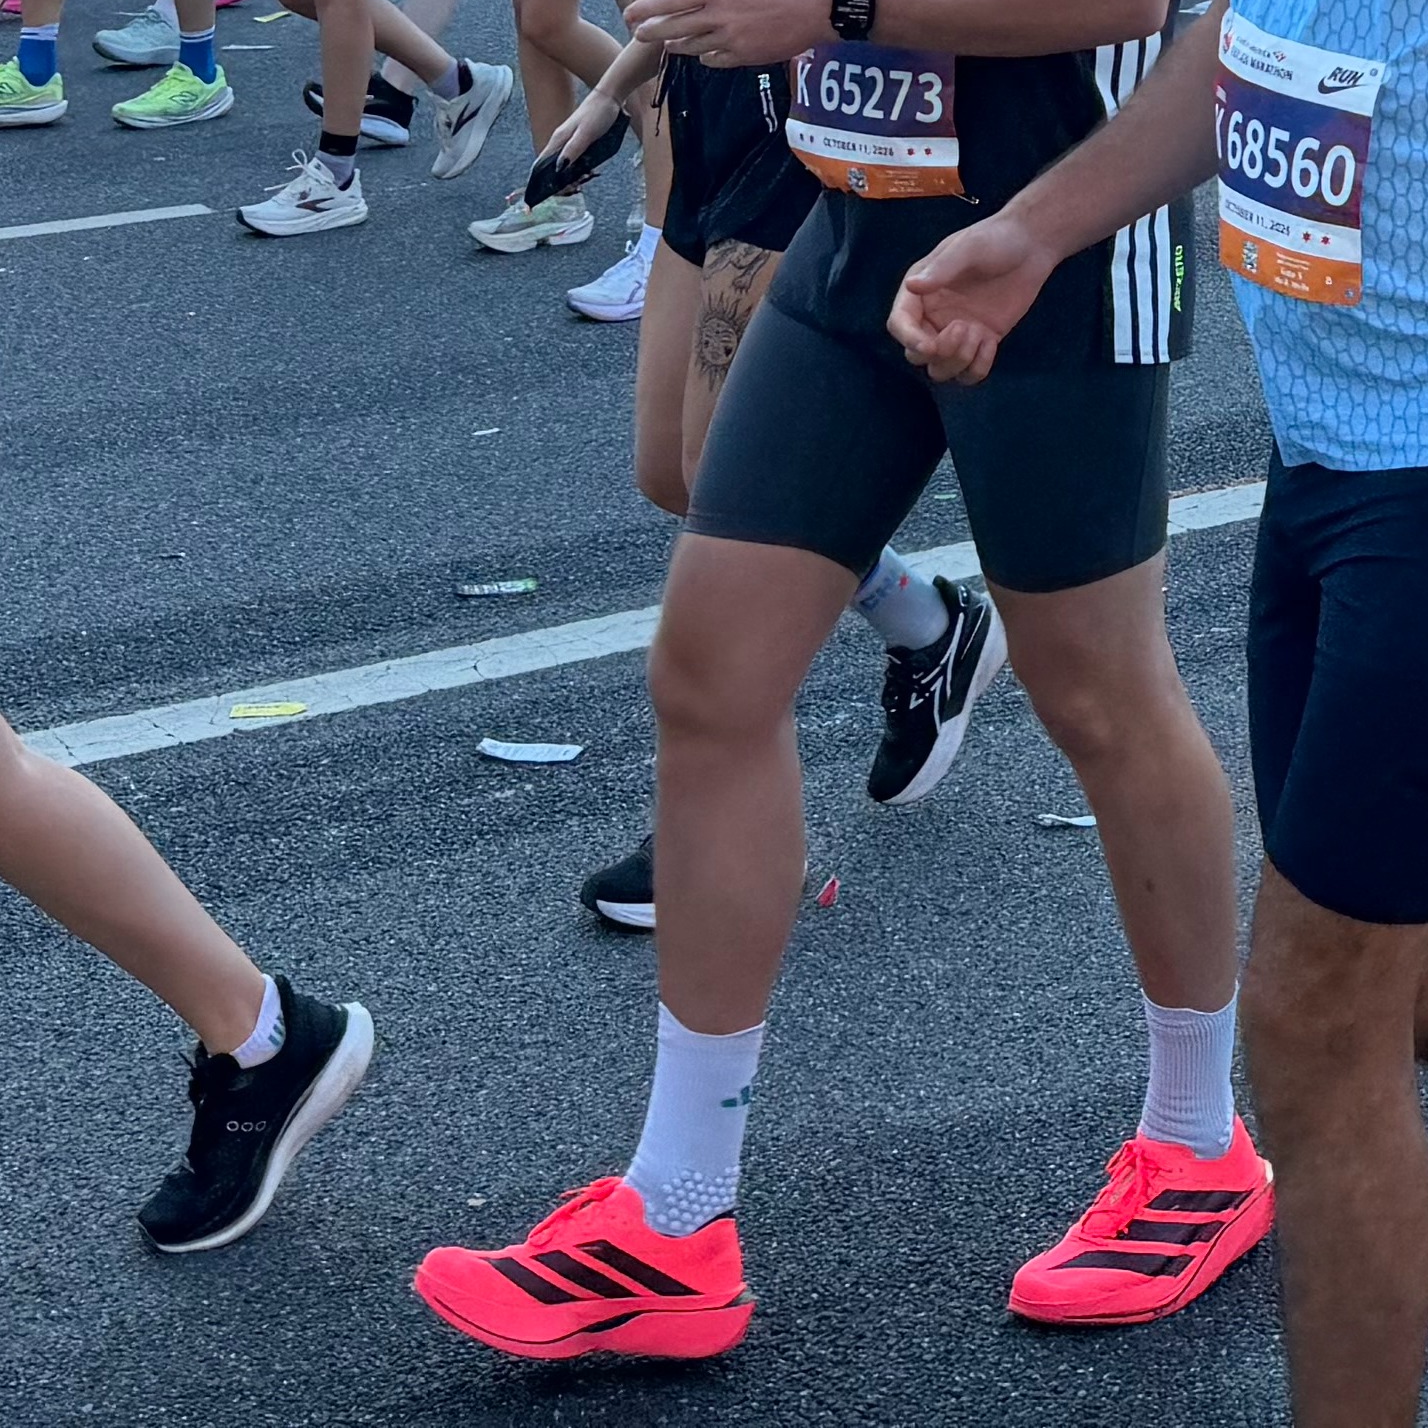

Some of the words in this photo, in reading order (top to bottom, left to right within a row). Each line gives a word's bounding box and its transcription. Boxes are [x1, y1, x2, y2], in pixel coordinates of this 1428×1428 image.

[797, 60, 812, 107] K
[819, 60, 944, 124] 65273
[1327, 65, 1365, 86] RUN
[1227, 110, 1356, 207] 68560
